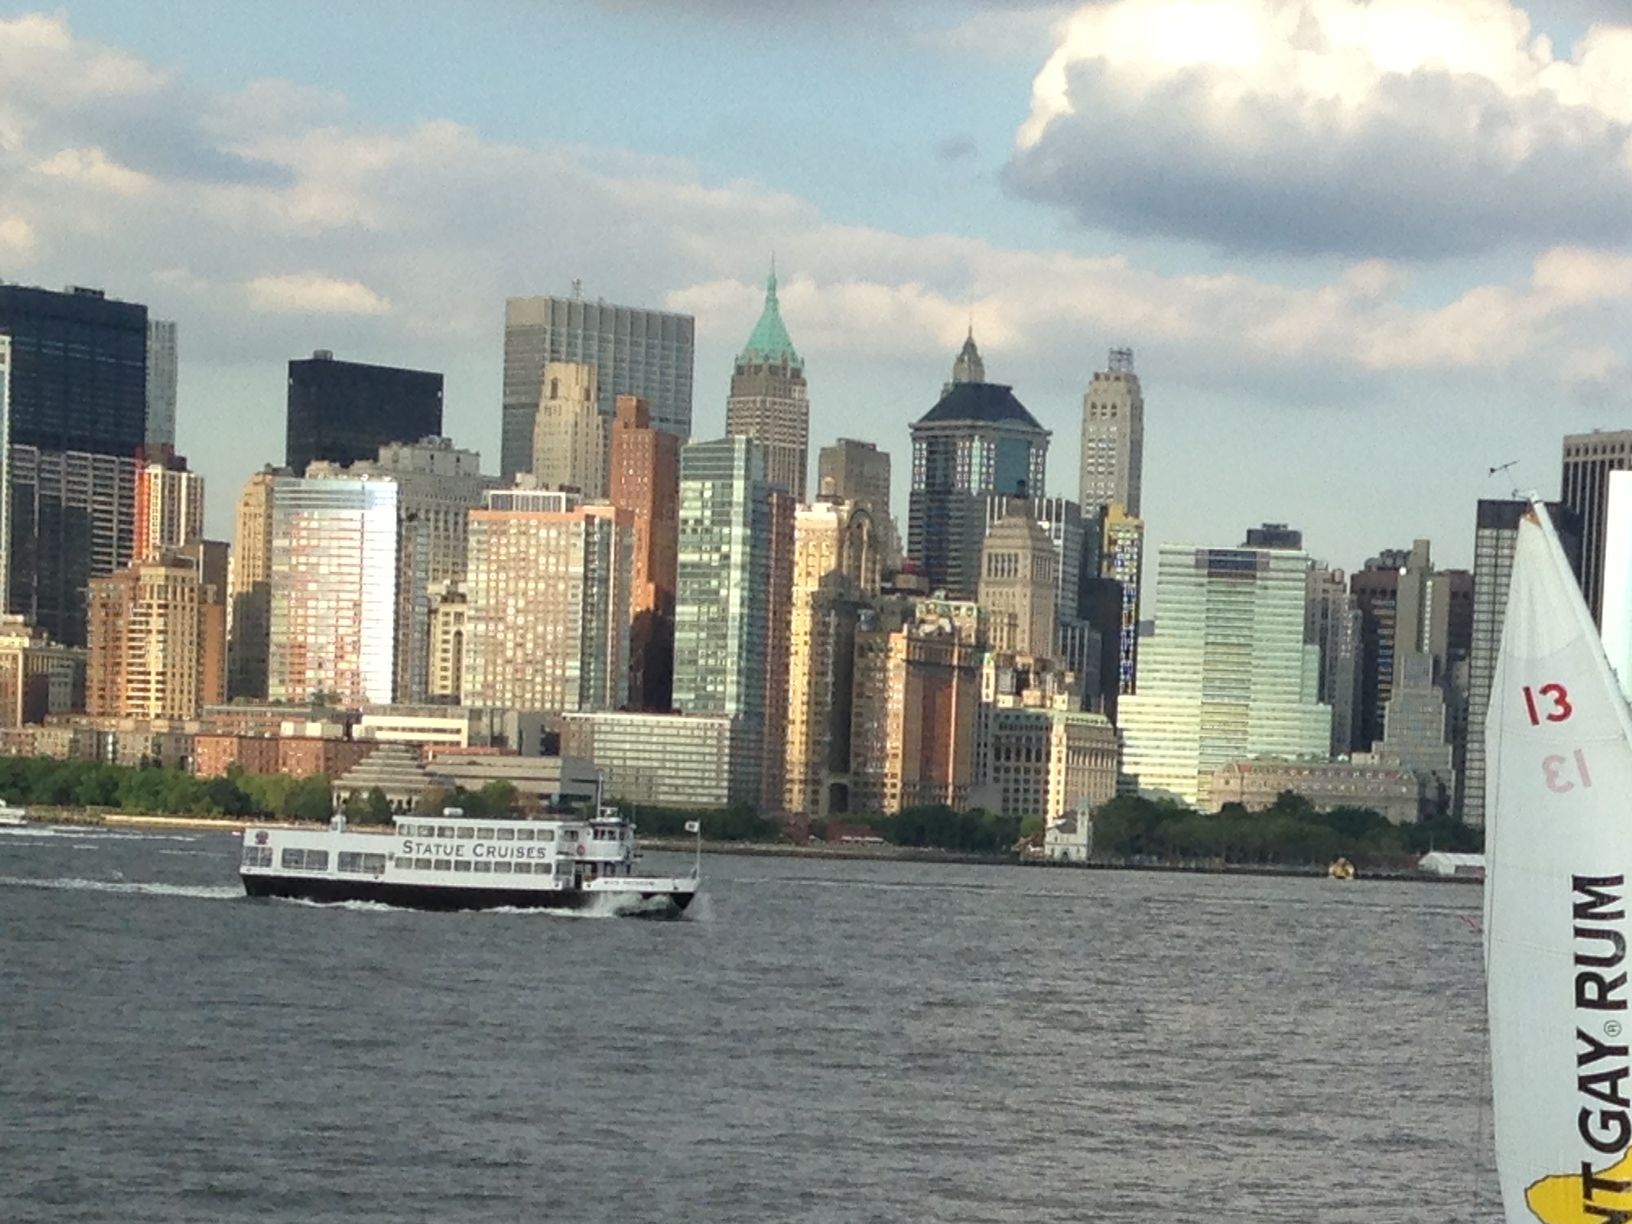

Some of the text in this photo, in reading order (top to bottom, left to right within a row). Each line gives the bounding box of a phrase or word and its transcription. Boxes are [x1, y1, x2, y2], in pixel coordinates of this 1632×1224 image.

[1523, 683, 1573, 726] 13
[402, 839, 547, 859] STATUE CRUISES
[1571, 874, 1629, 1011] RUM
